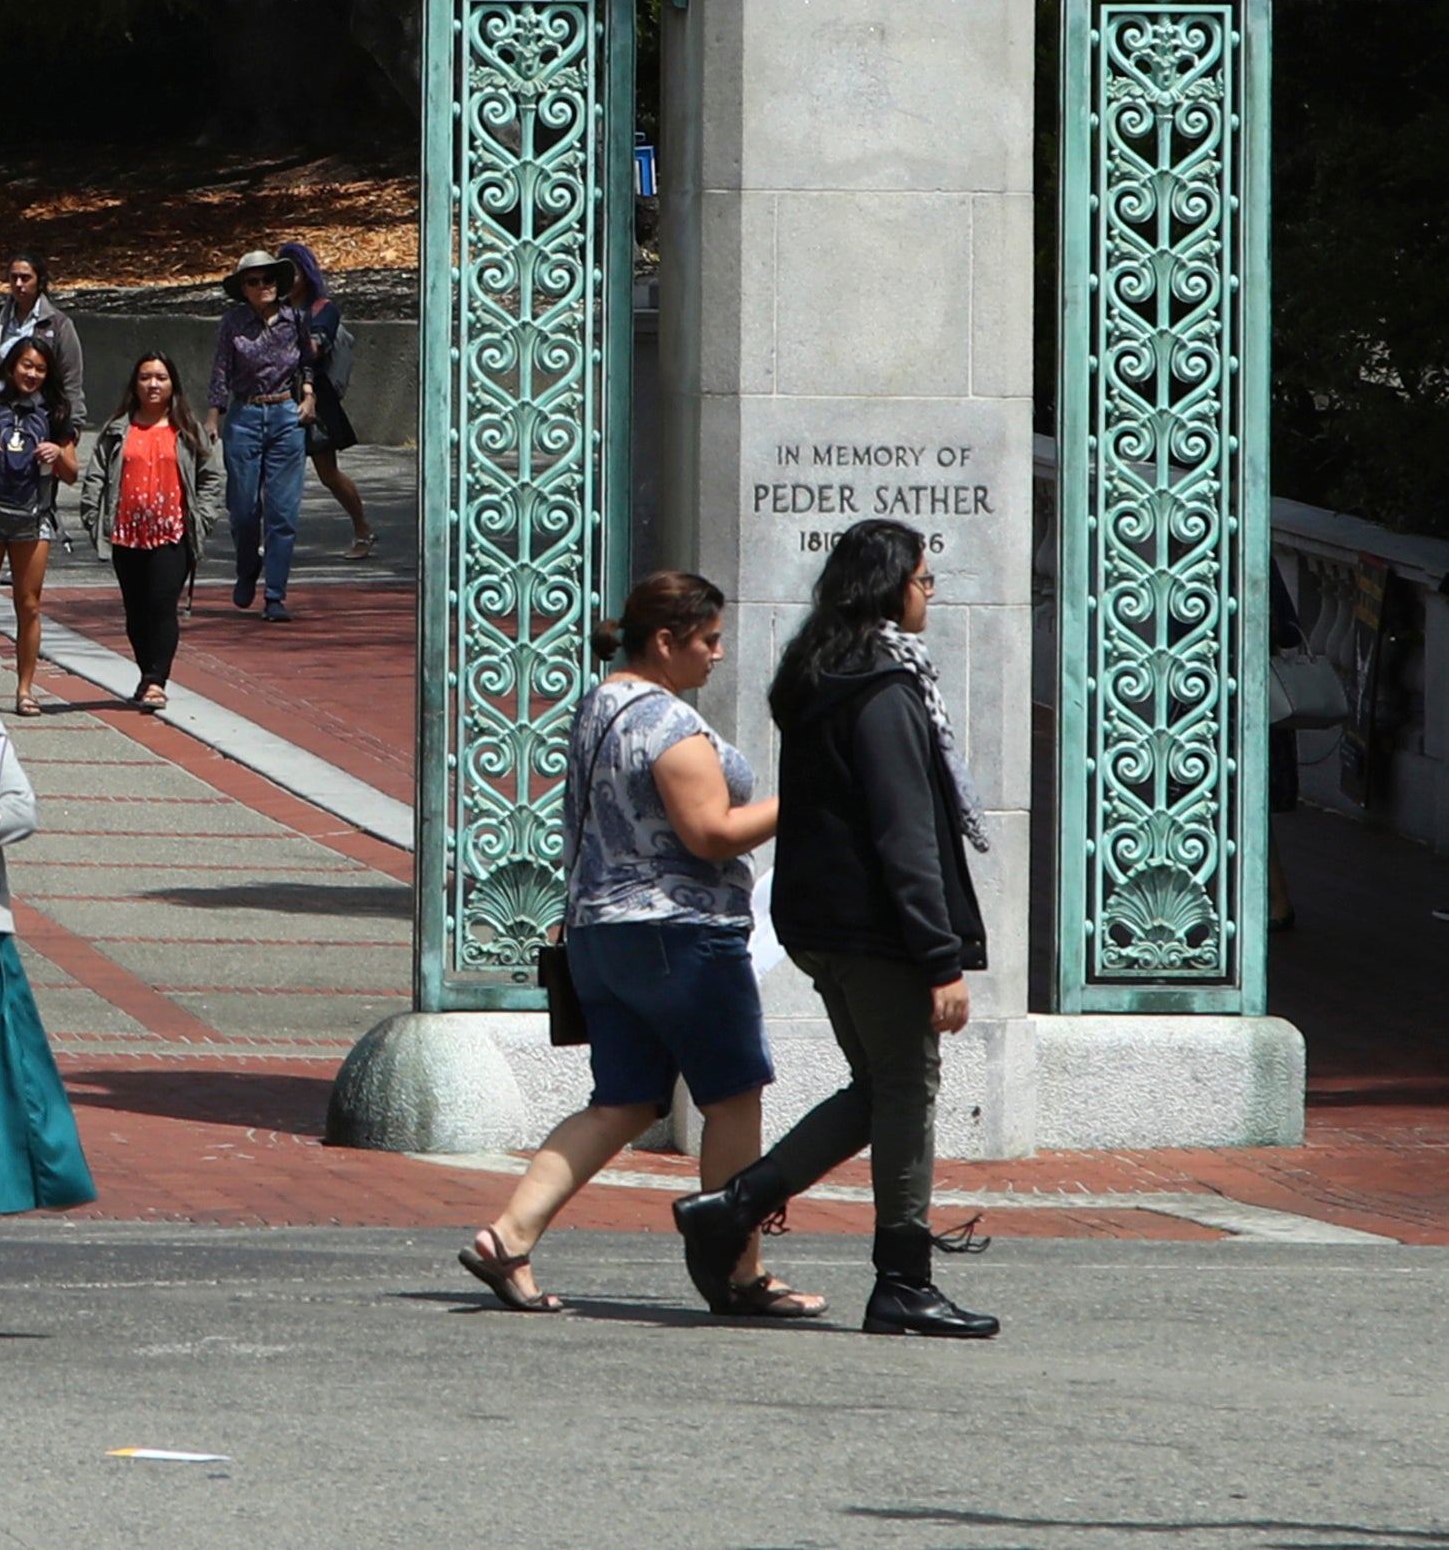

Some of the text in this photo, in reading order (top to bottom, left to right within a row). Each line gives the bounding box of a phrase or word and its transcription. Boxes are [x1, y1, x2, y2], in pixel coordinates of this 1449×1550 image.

[777, 446, 972, 467] IN MEMORY OF
[754, 484, 995, 515] PEDER SATHER
